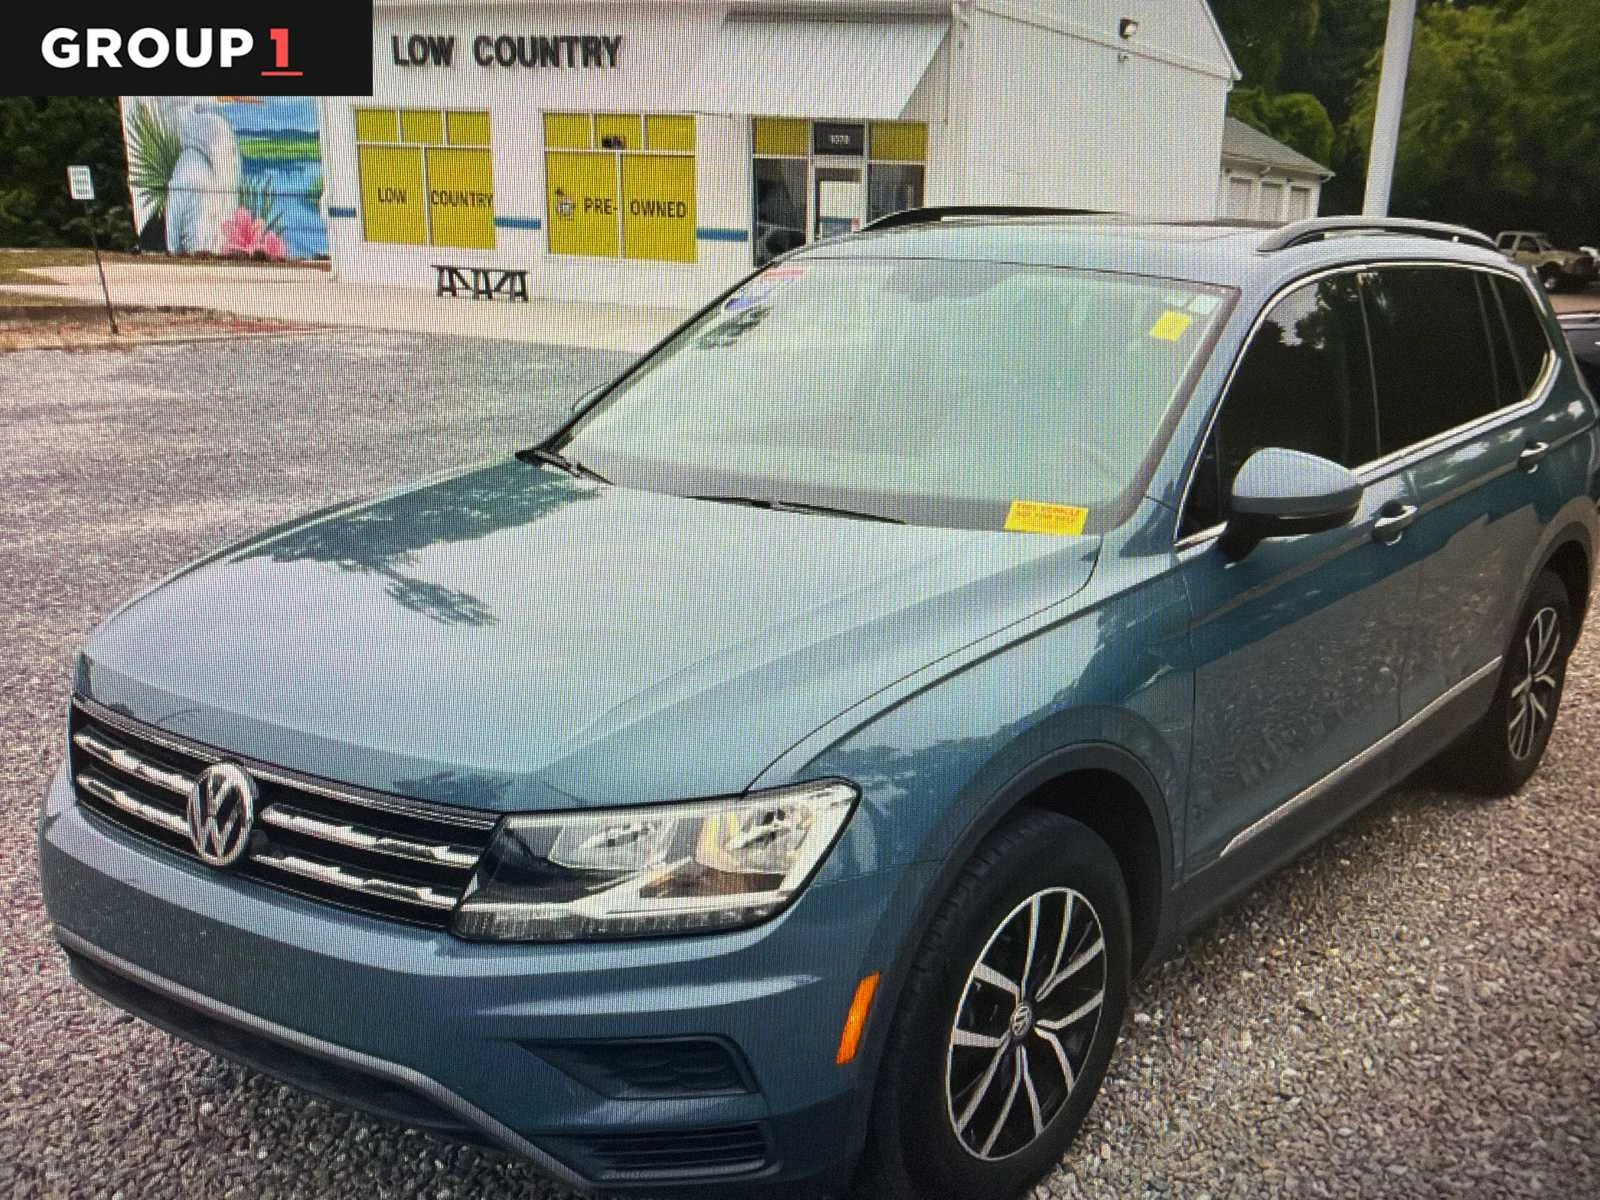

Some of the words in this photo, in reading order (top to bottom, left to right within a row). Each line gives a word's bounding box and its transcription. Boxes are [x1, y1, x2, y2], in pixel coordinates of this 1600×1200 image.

[392, 34, 455, 67] LOW
[473, 34, 623, 69] COUNTRY
[377, 187, 407, 204] LOW
[430, 189, 493, 208] COUNTRY
[583, 197, 619, 216] PRE-
[629, 198, 687, 218] OWNED
[188, 762, 254, 866] VW
